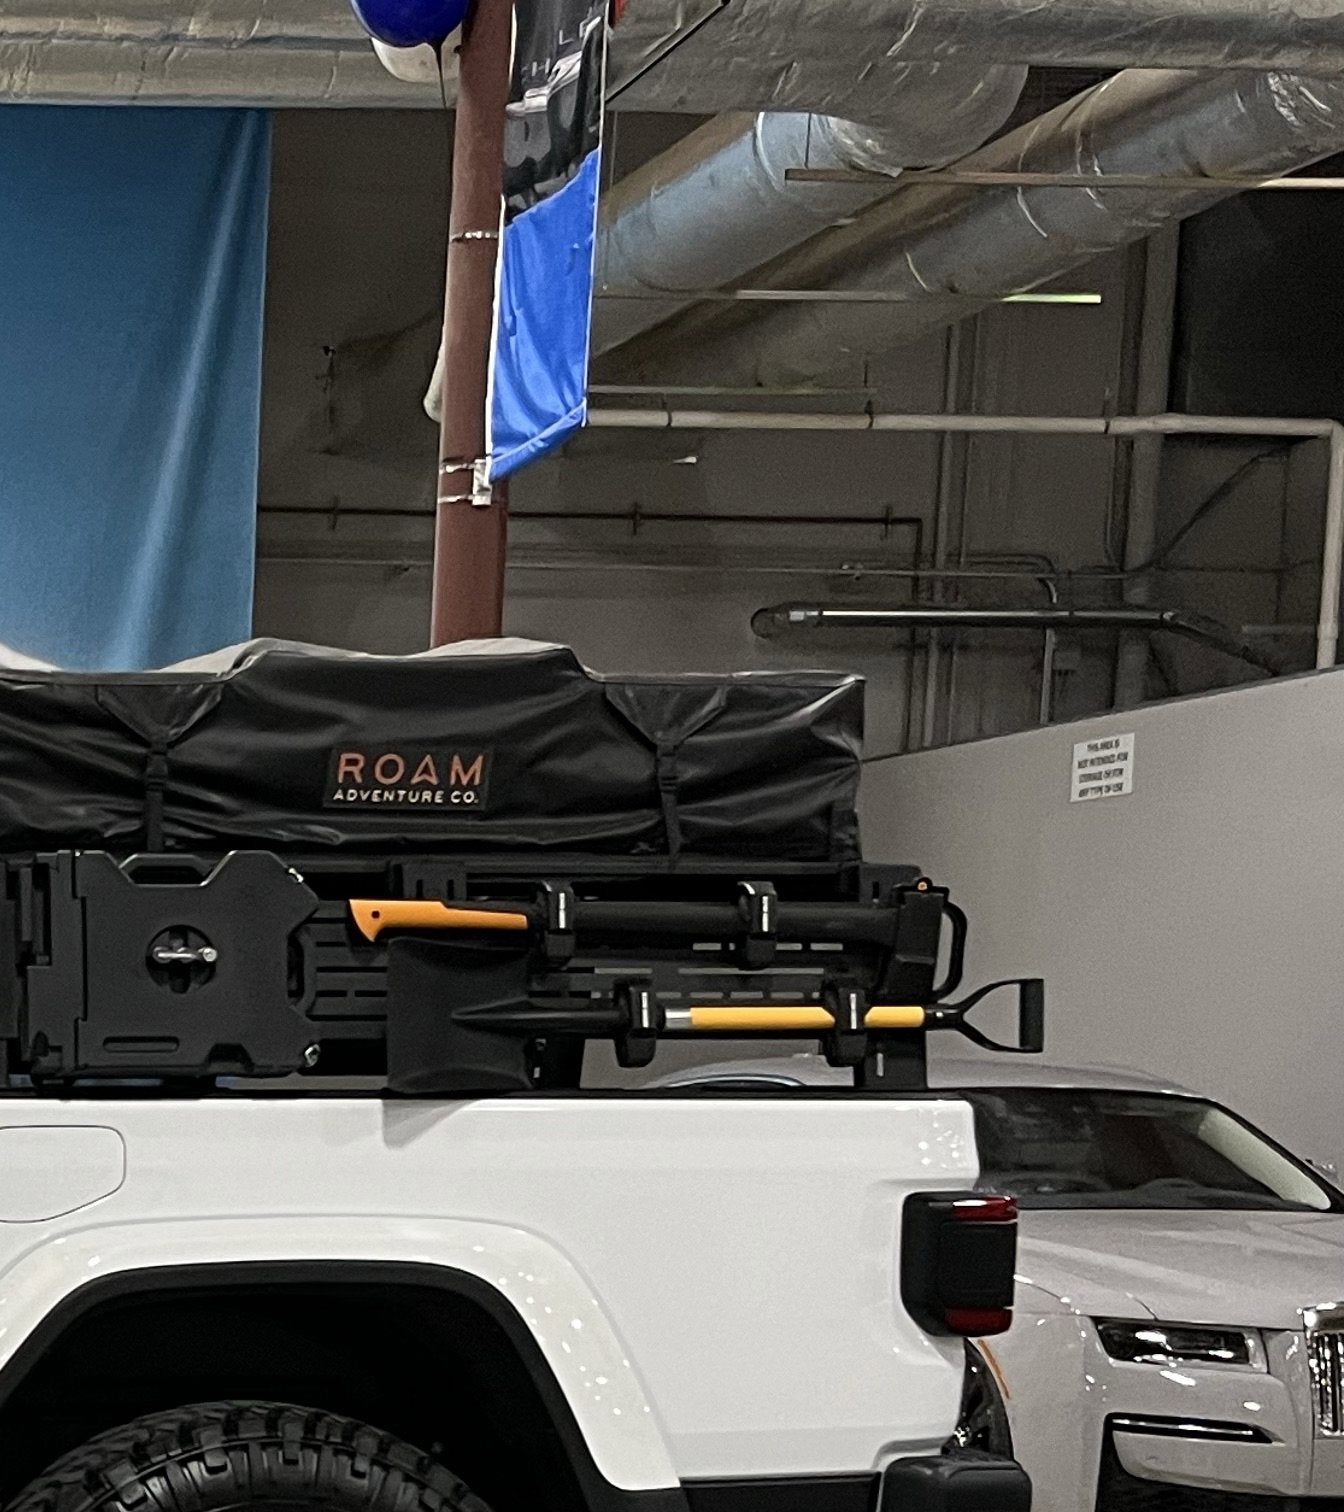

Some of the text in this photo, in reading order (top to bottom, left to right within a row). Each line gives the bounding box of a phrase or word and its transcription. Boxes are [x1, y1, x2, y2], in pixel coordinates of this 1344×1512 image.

[337, 752, 484, 786] ROAM
[333, 789, 479, 804] ADVENTURE CO.
